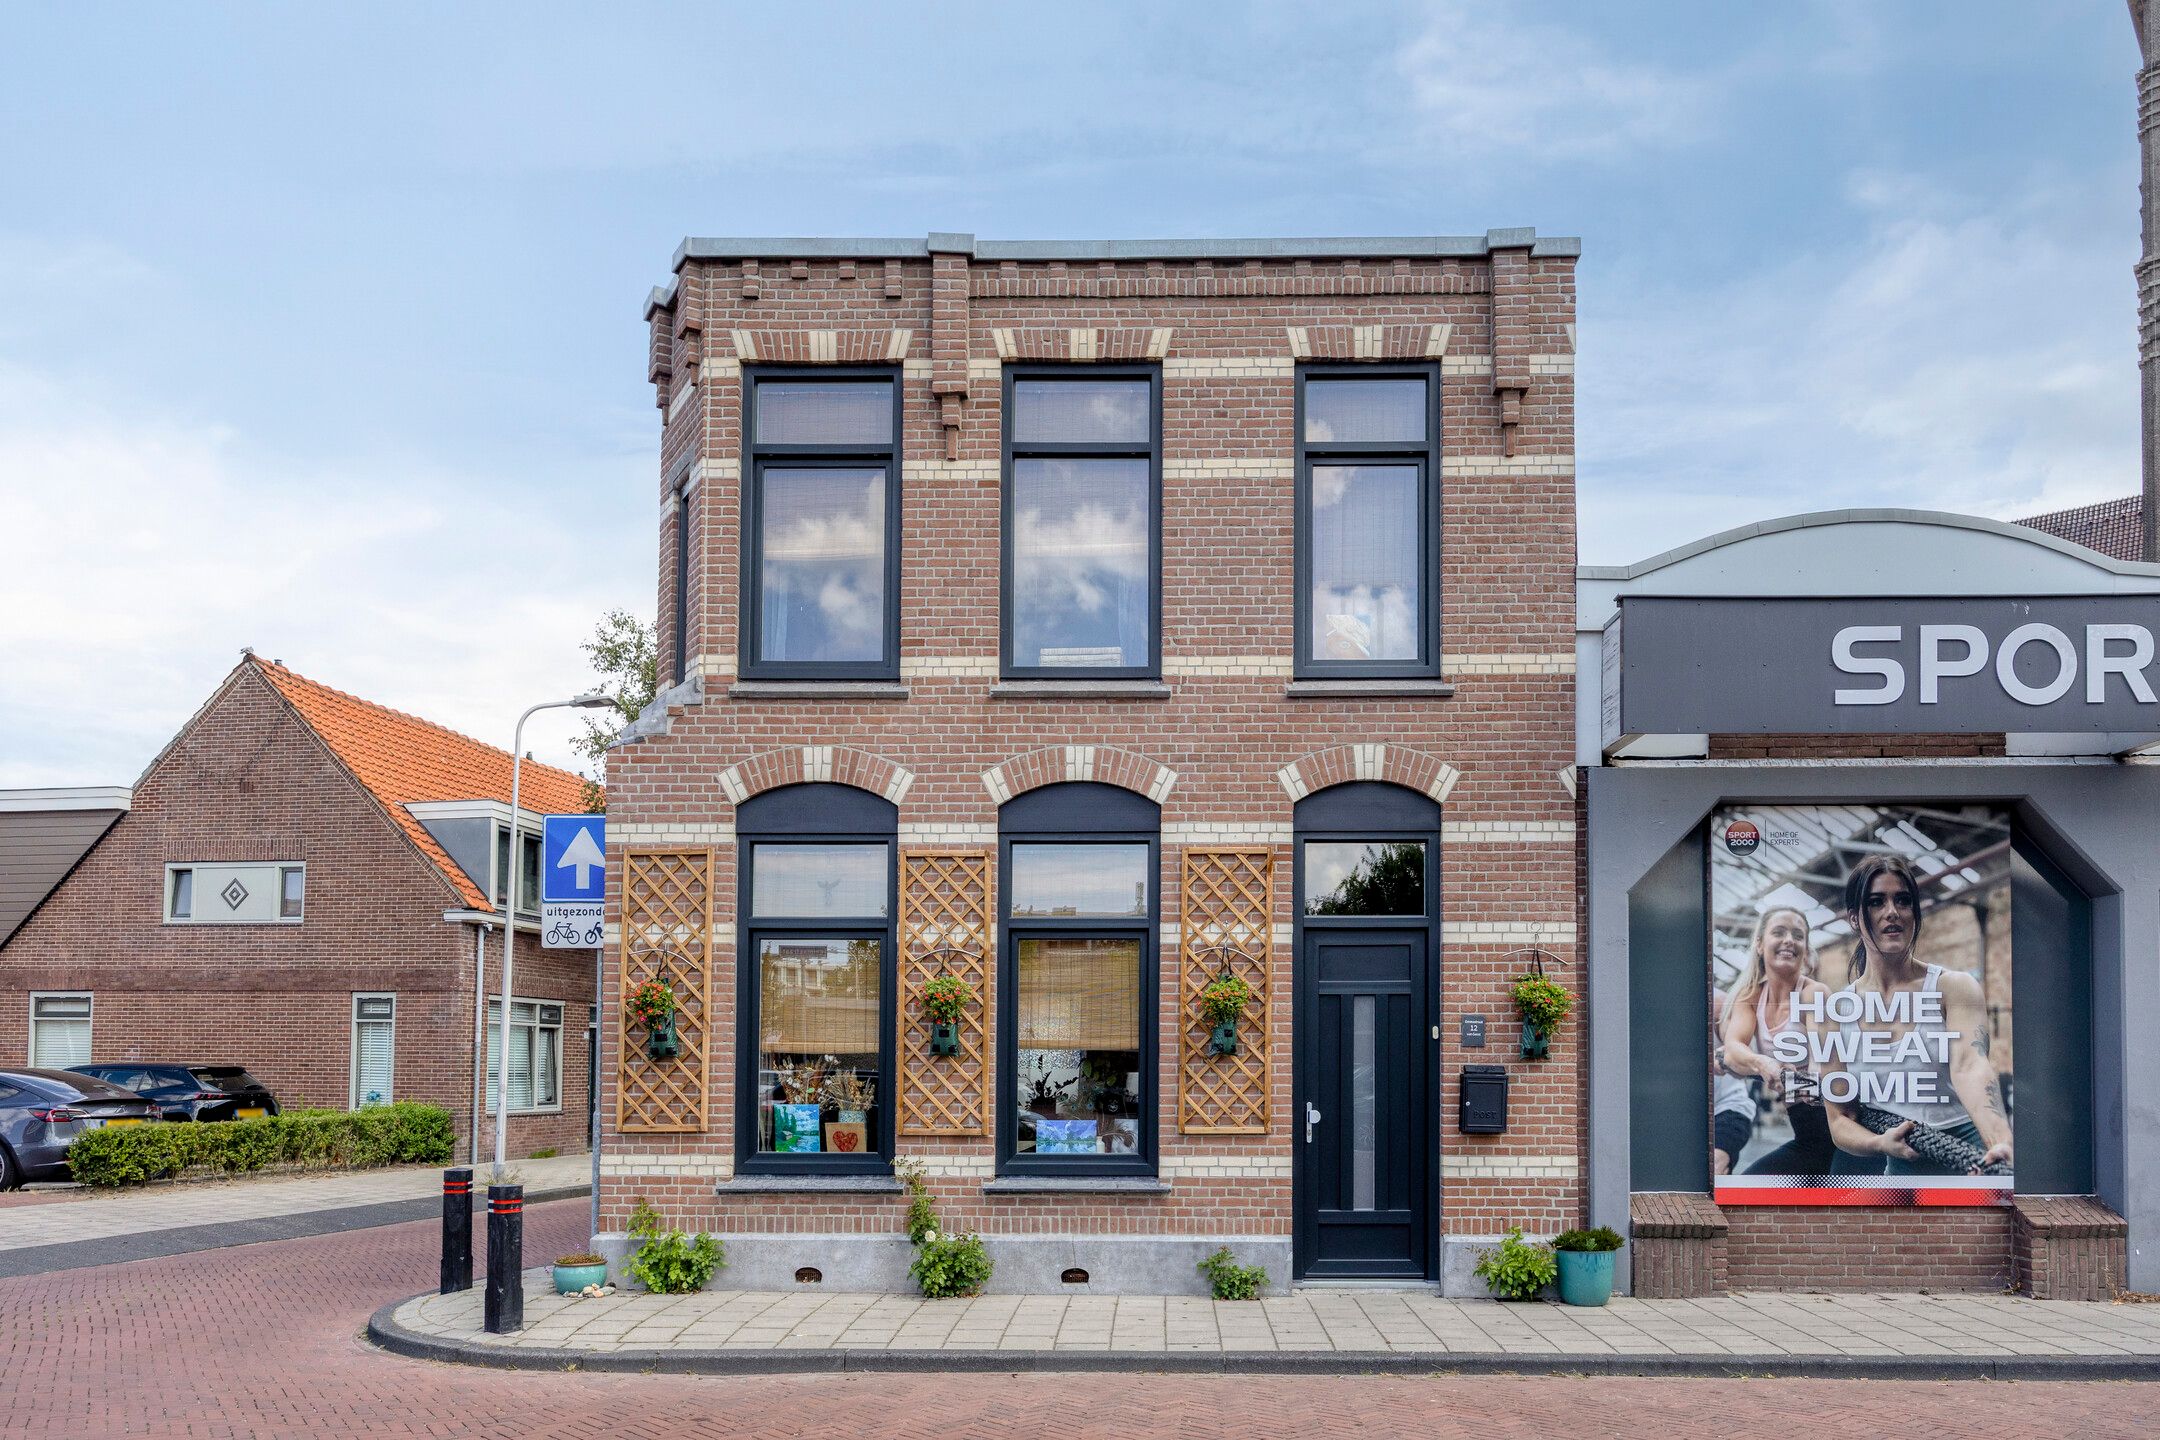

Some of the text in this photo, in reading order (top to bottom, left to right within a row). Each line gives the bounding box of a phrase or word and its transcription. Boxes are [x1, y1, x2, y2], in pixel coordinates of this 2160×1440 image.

[1831, 622, 2159, 706] SPOR
[1727, 831, 1757, 839] SPORT
[1769, 831, 1799, 839] HOME OF
[1730, 838, 1755, 846] 2000
[1770, 838, 1800, 846] EXPERTS
[1789, 991, 1943, 1023] HOME
[1470, 1024, 1478, 1032] 12
[1772, 1031, 1961, 1063] SWEAT
[1784, 1071, 1950, 1104] HOME.
[1473, 1110, 1497, 1120] POST
